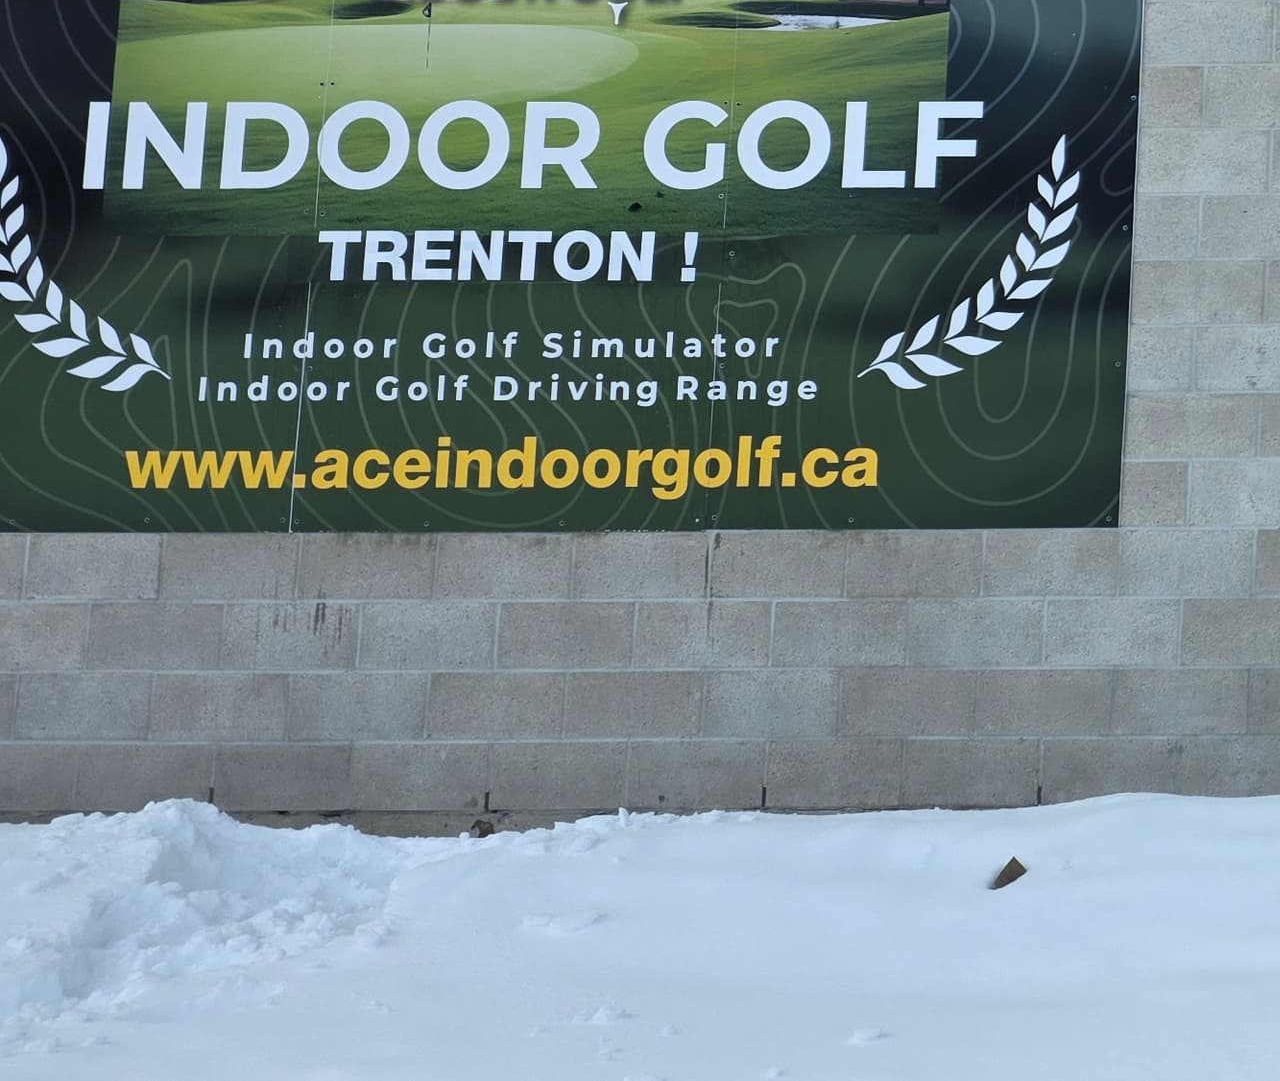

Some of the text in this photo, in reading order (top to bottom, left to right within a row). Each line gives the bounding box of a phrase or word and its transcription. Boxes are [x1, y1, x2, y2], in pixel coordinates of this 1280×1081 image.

[82, 99, 985, 191] INDOOR GOLF
[318, 229, 656, 282] TRENTON
[243, 329, 779, 360] Indoor Golf Simulator
[198, 373, 818, 407] Indoor Golf Driving Range
[125, 434, 879, 501] www.aceindoorgolf.ca
